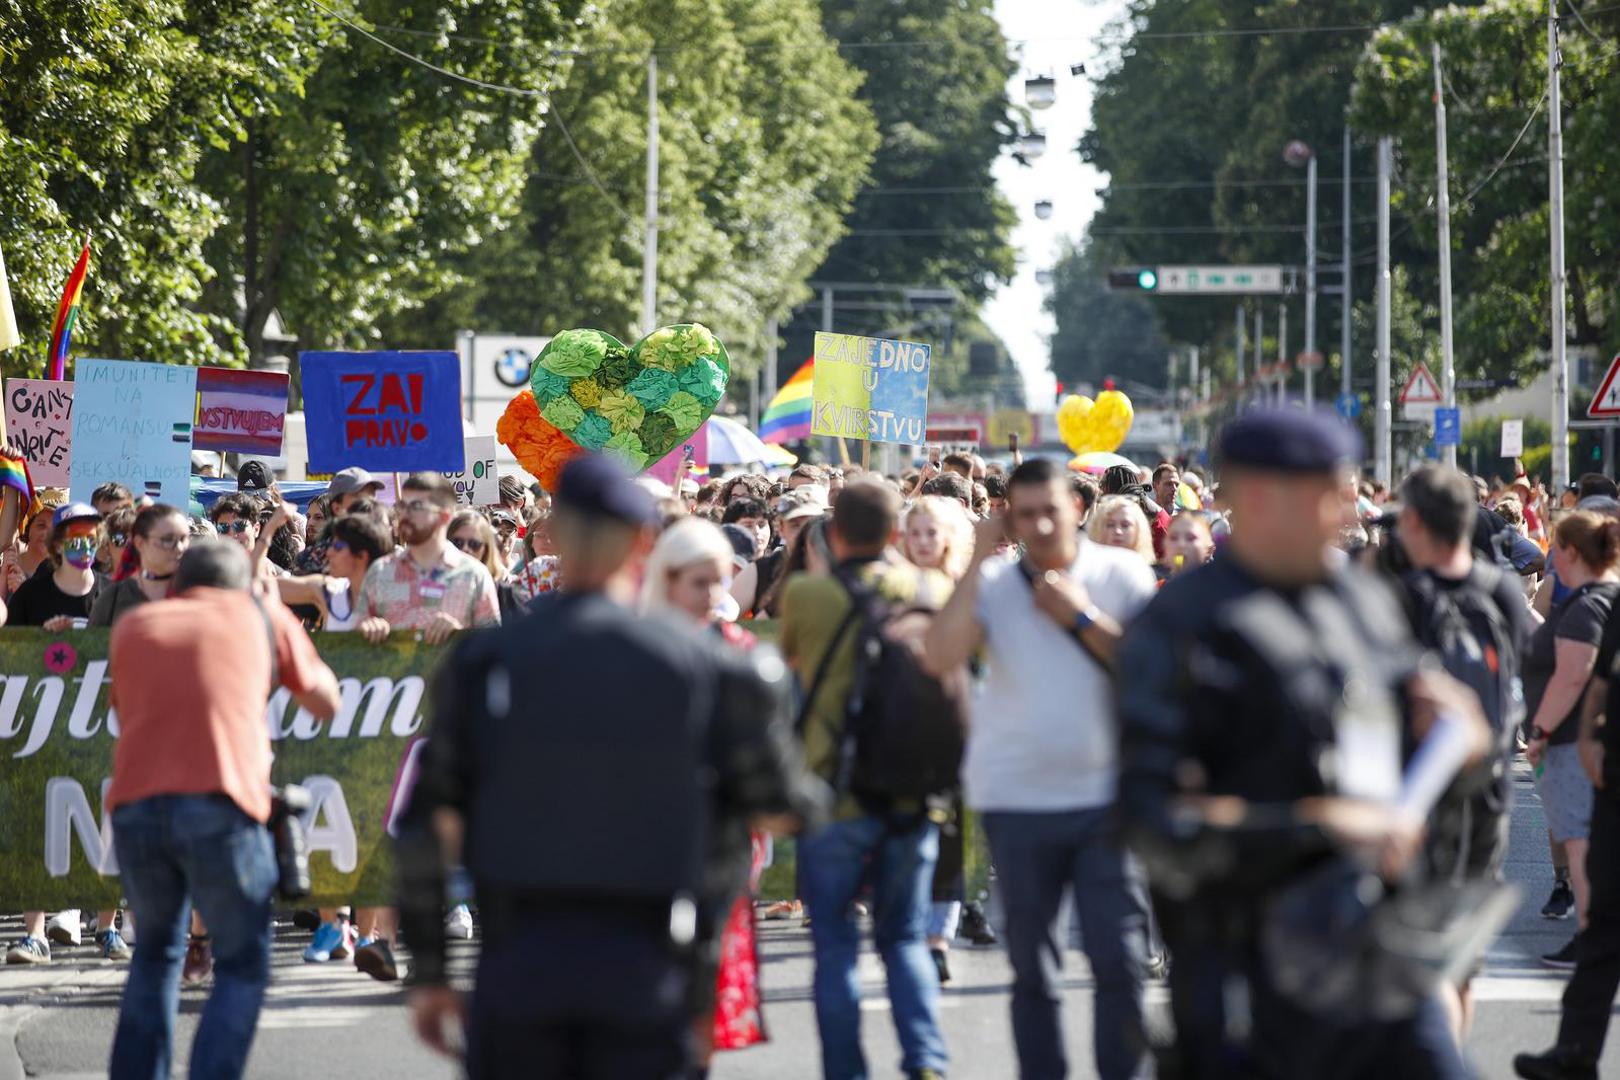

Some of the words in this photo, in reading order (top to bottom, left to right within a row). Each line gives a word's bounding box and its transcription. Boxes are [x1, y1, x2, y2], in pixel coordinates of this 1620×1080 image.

[817, 335, 926, 373] ZAJEDNO
[84, 365, 195, 384] IMUNITET
[862, 369, 879, 392] U
[114, 386, 143, 404] NA
[75, 411, 169, 438] ROMANSU
[815, 401, 922, 441] KVIRSTVU
[473, 460, 494, 479] OF
